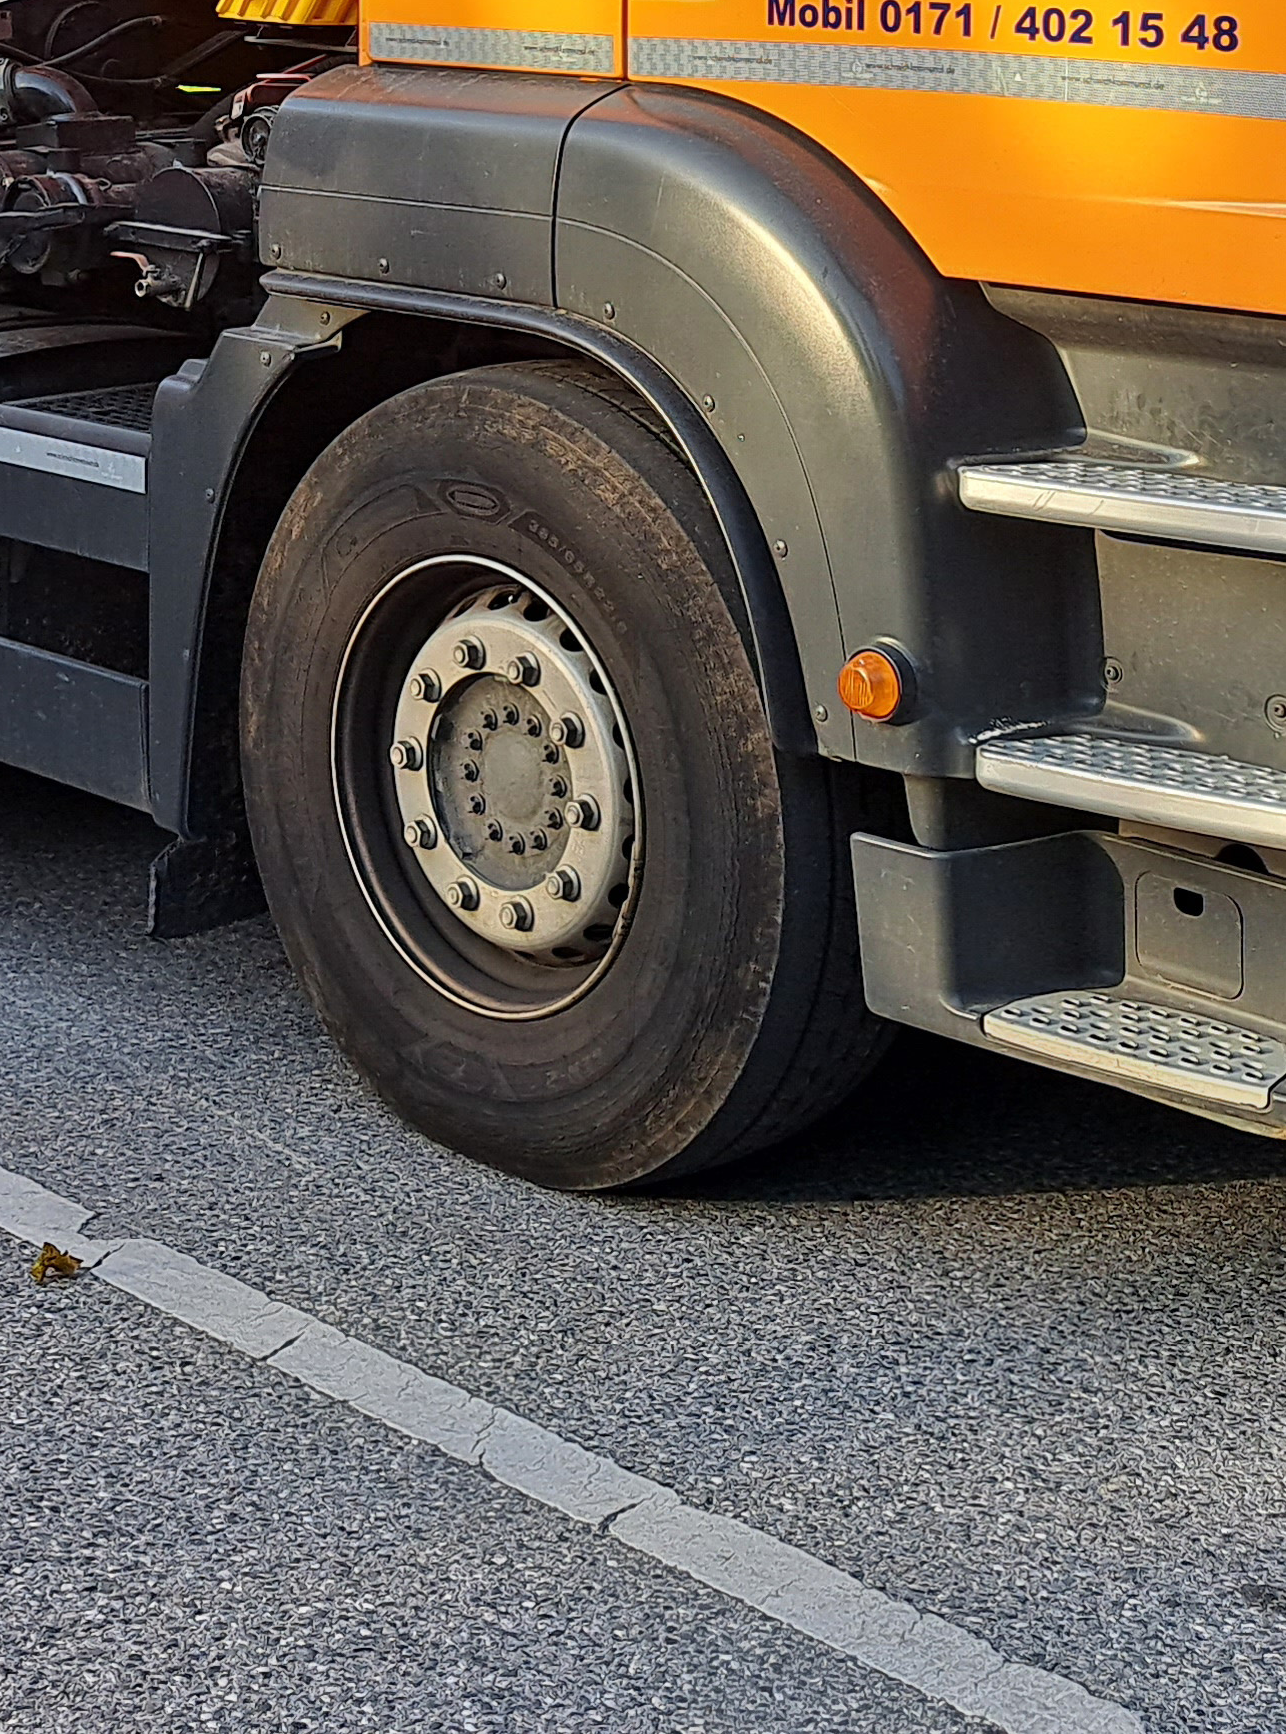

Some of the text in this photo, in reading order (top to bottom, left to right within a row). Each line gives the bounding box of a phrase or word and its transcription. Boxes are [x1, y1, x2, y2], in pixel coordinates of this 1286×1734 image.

[879, 0, 972, 37] 0171
[989, 4, 1003, 40] /
[1013, 6, 1094, 46] 402
[1111, 10, 1165, 49] 15
[1180, 13, 1240, 53] 48
